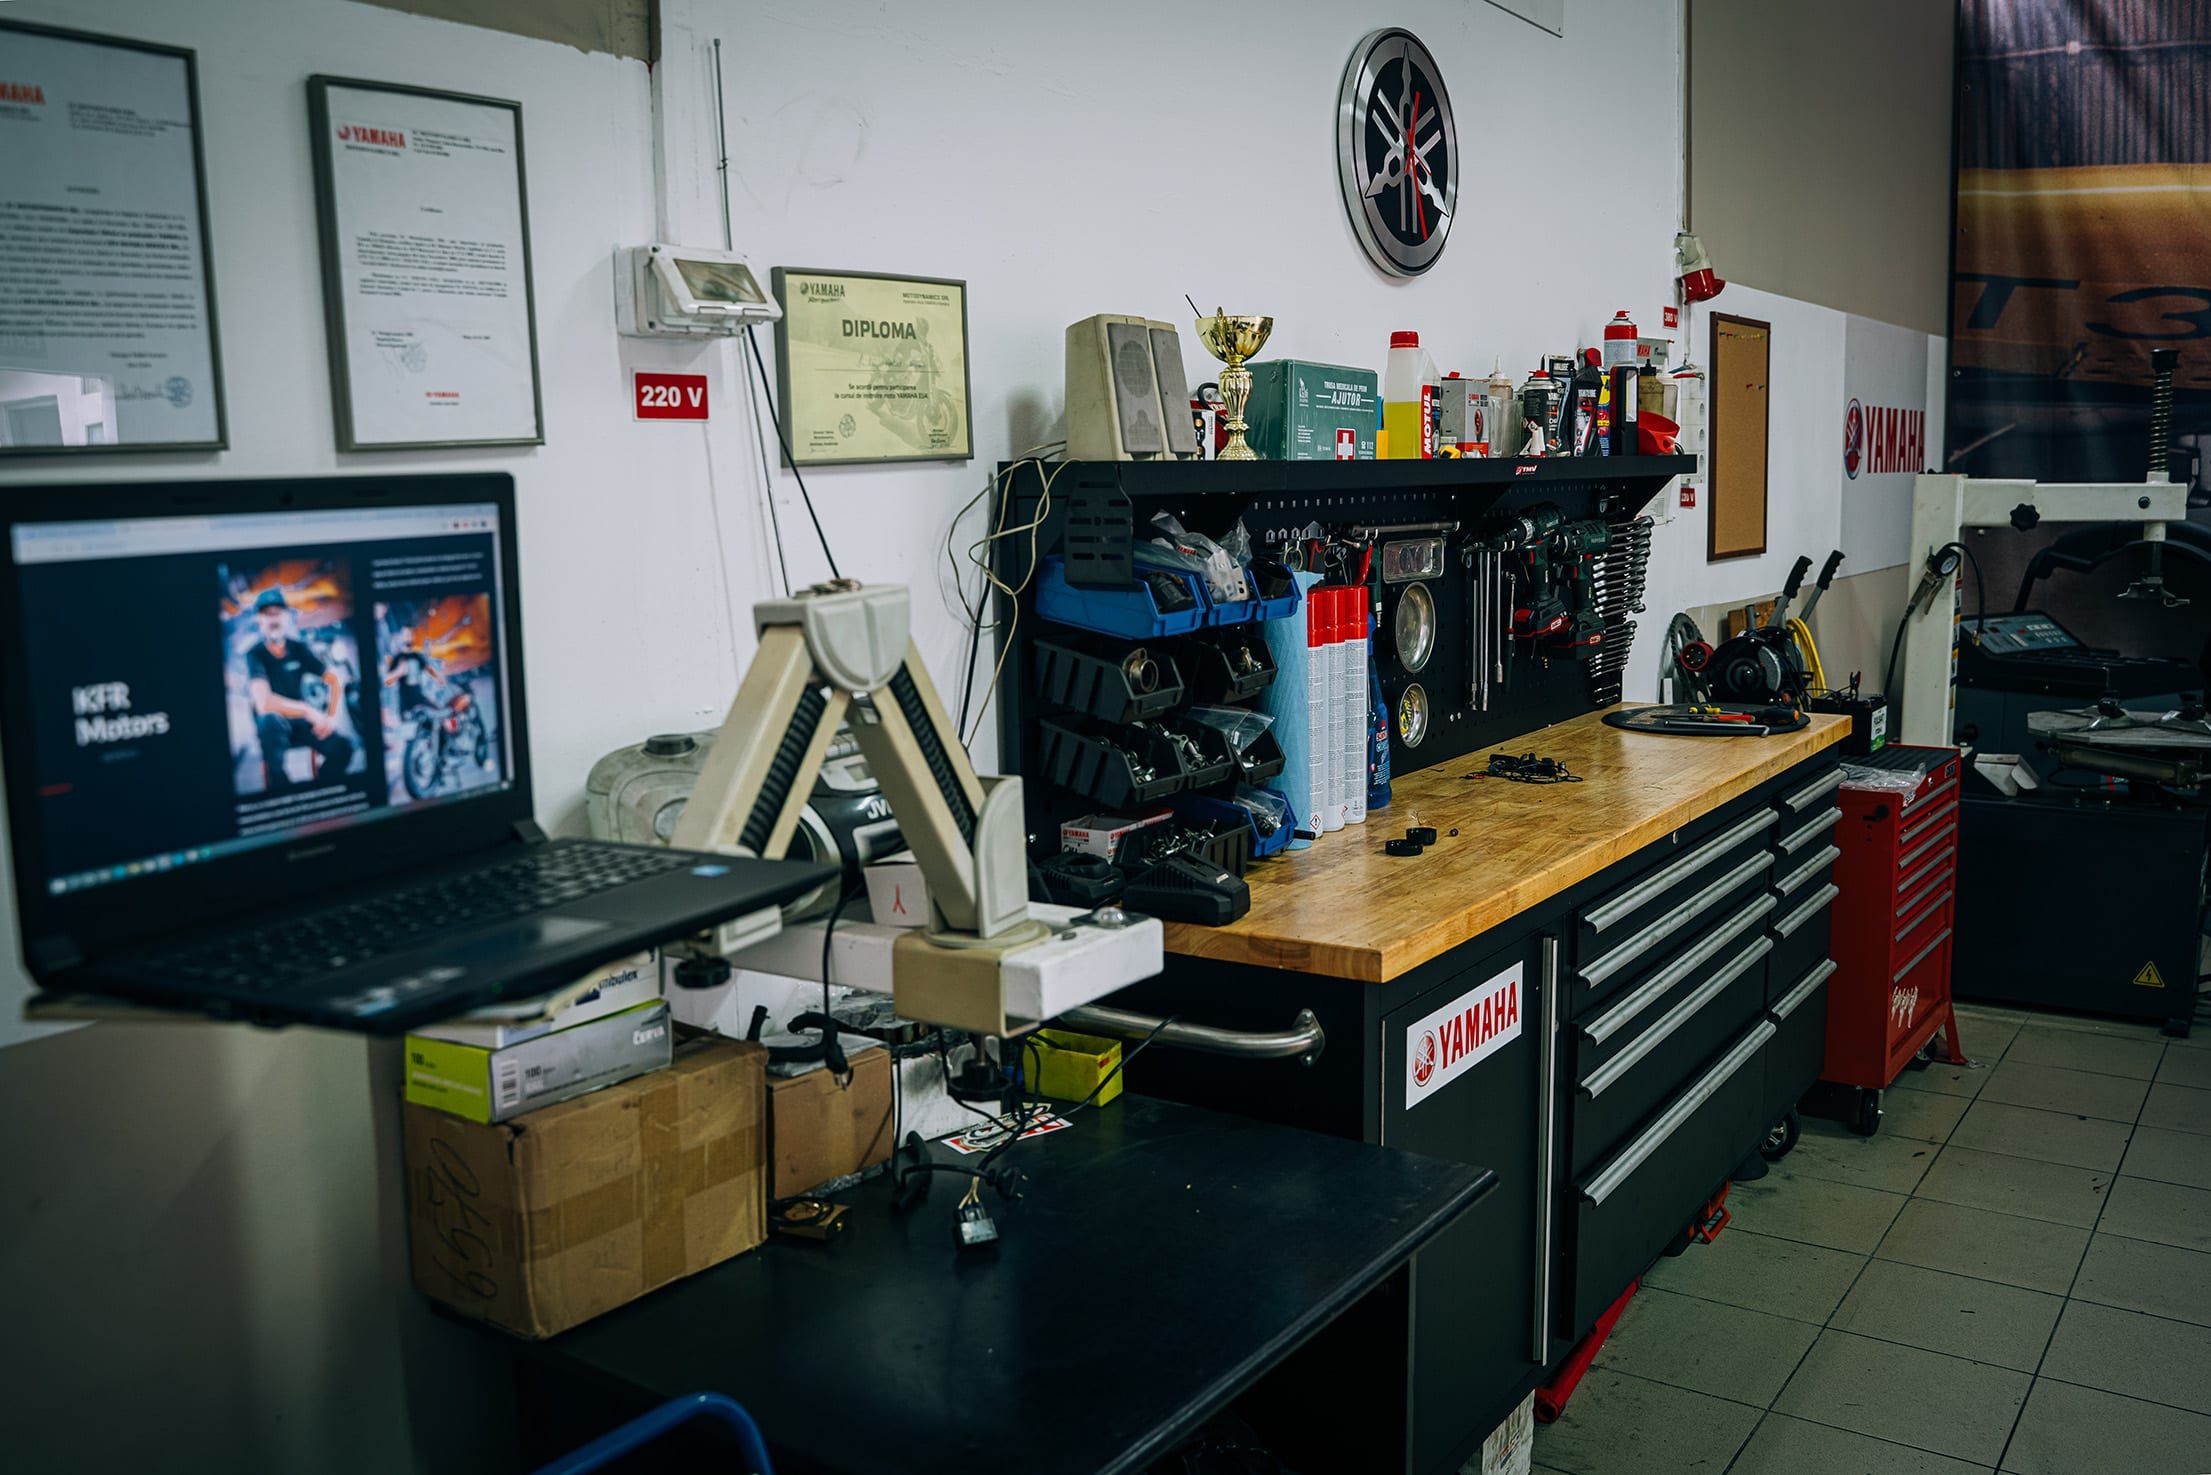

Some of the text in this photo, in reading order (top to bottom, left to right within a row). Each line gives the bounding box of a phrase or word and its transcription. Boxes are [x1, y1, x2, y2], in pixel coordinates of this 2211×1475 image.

[352, 126, 406, 149] YAMAHA
[810, 281, 845, 297] YAMAHA
[842, 319, 917, 340] DIPLOMA
[641, 386, 703, 408] 220 V
[1331, 391, 1361, 406] AJUTOR
[1424, 393, 1432, 455] MOTUL
[1865, 406, 1924, 474] YAMAHA
[73, 682, 131, 715] KFR
[75, 712, 170, 747] Motors
[1439, 981, 1518, 1069] YAMAHA
